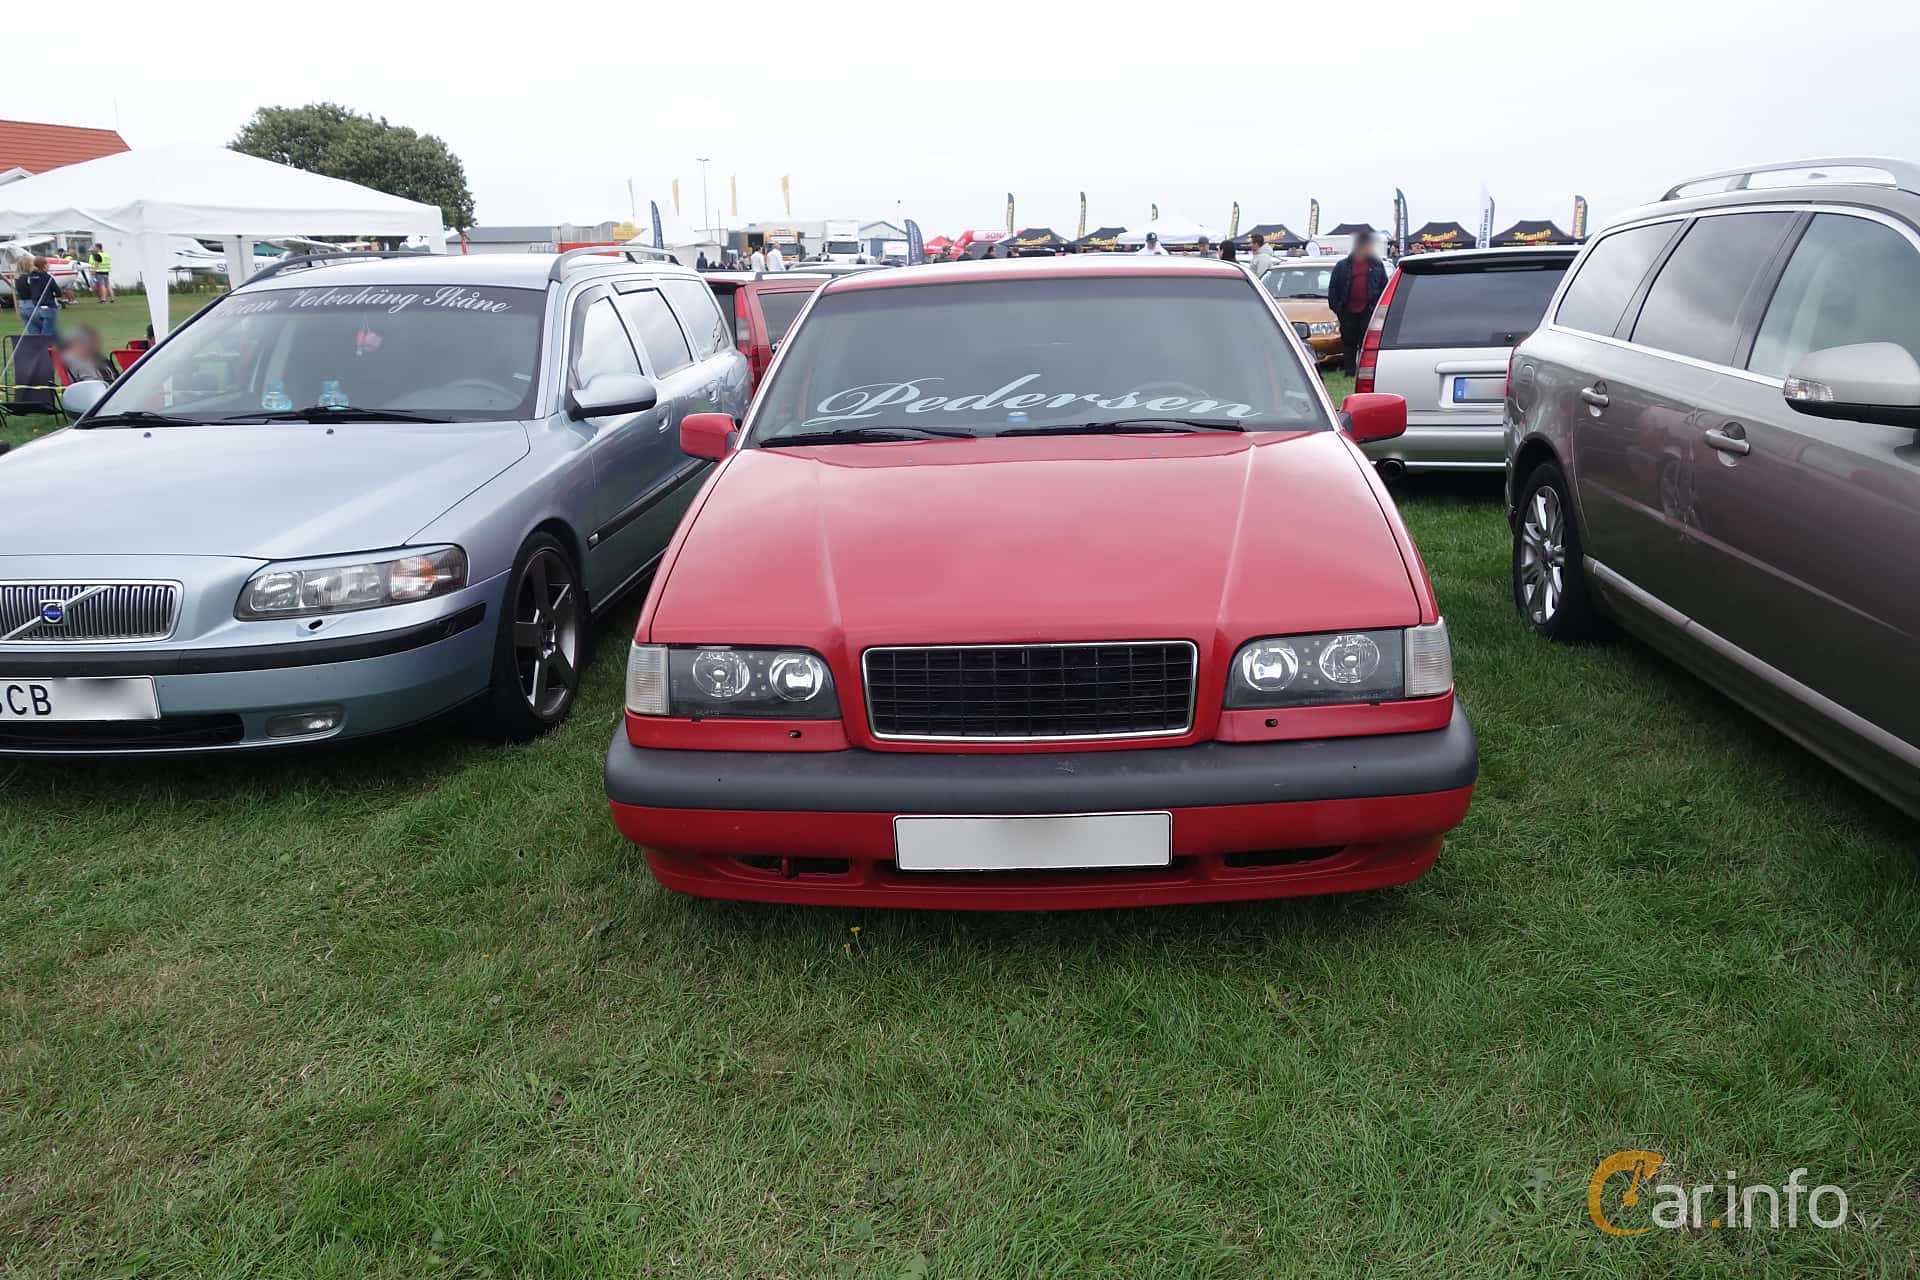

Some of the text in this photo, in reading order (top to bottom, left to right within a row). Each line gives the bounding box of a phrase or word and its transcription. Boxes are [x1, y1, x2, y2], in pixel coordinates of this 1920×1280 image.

[422, 286, 513, 314] Skåne
[801, 373, 1262, 427] Pedersen
[0, 683, 52, 716] CB
